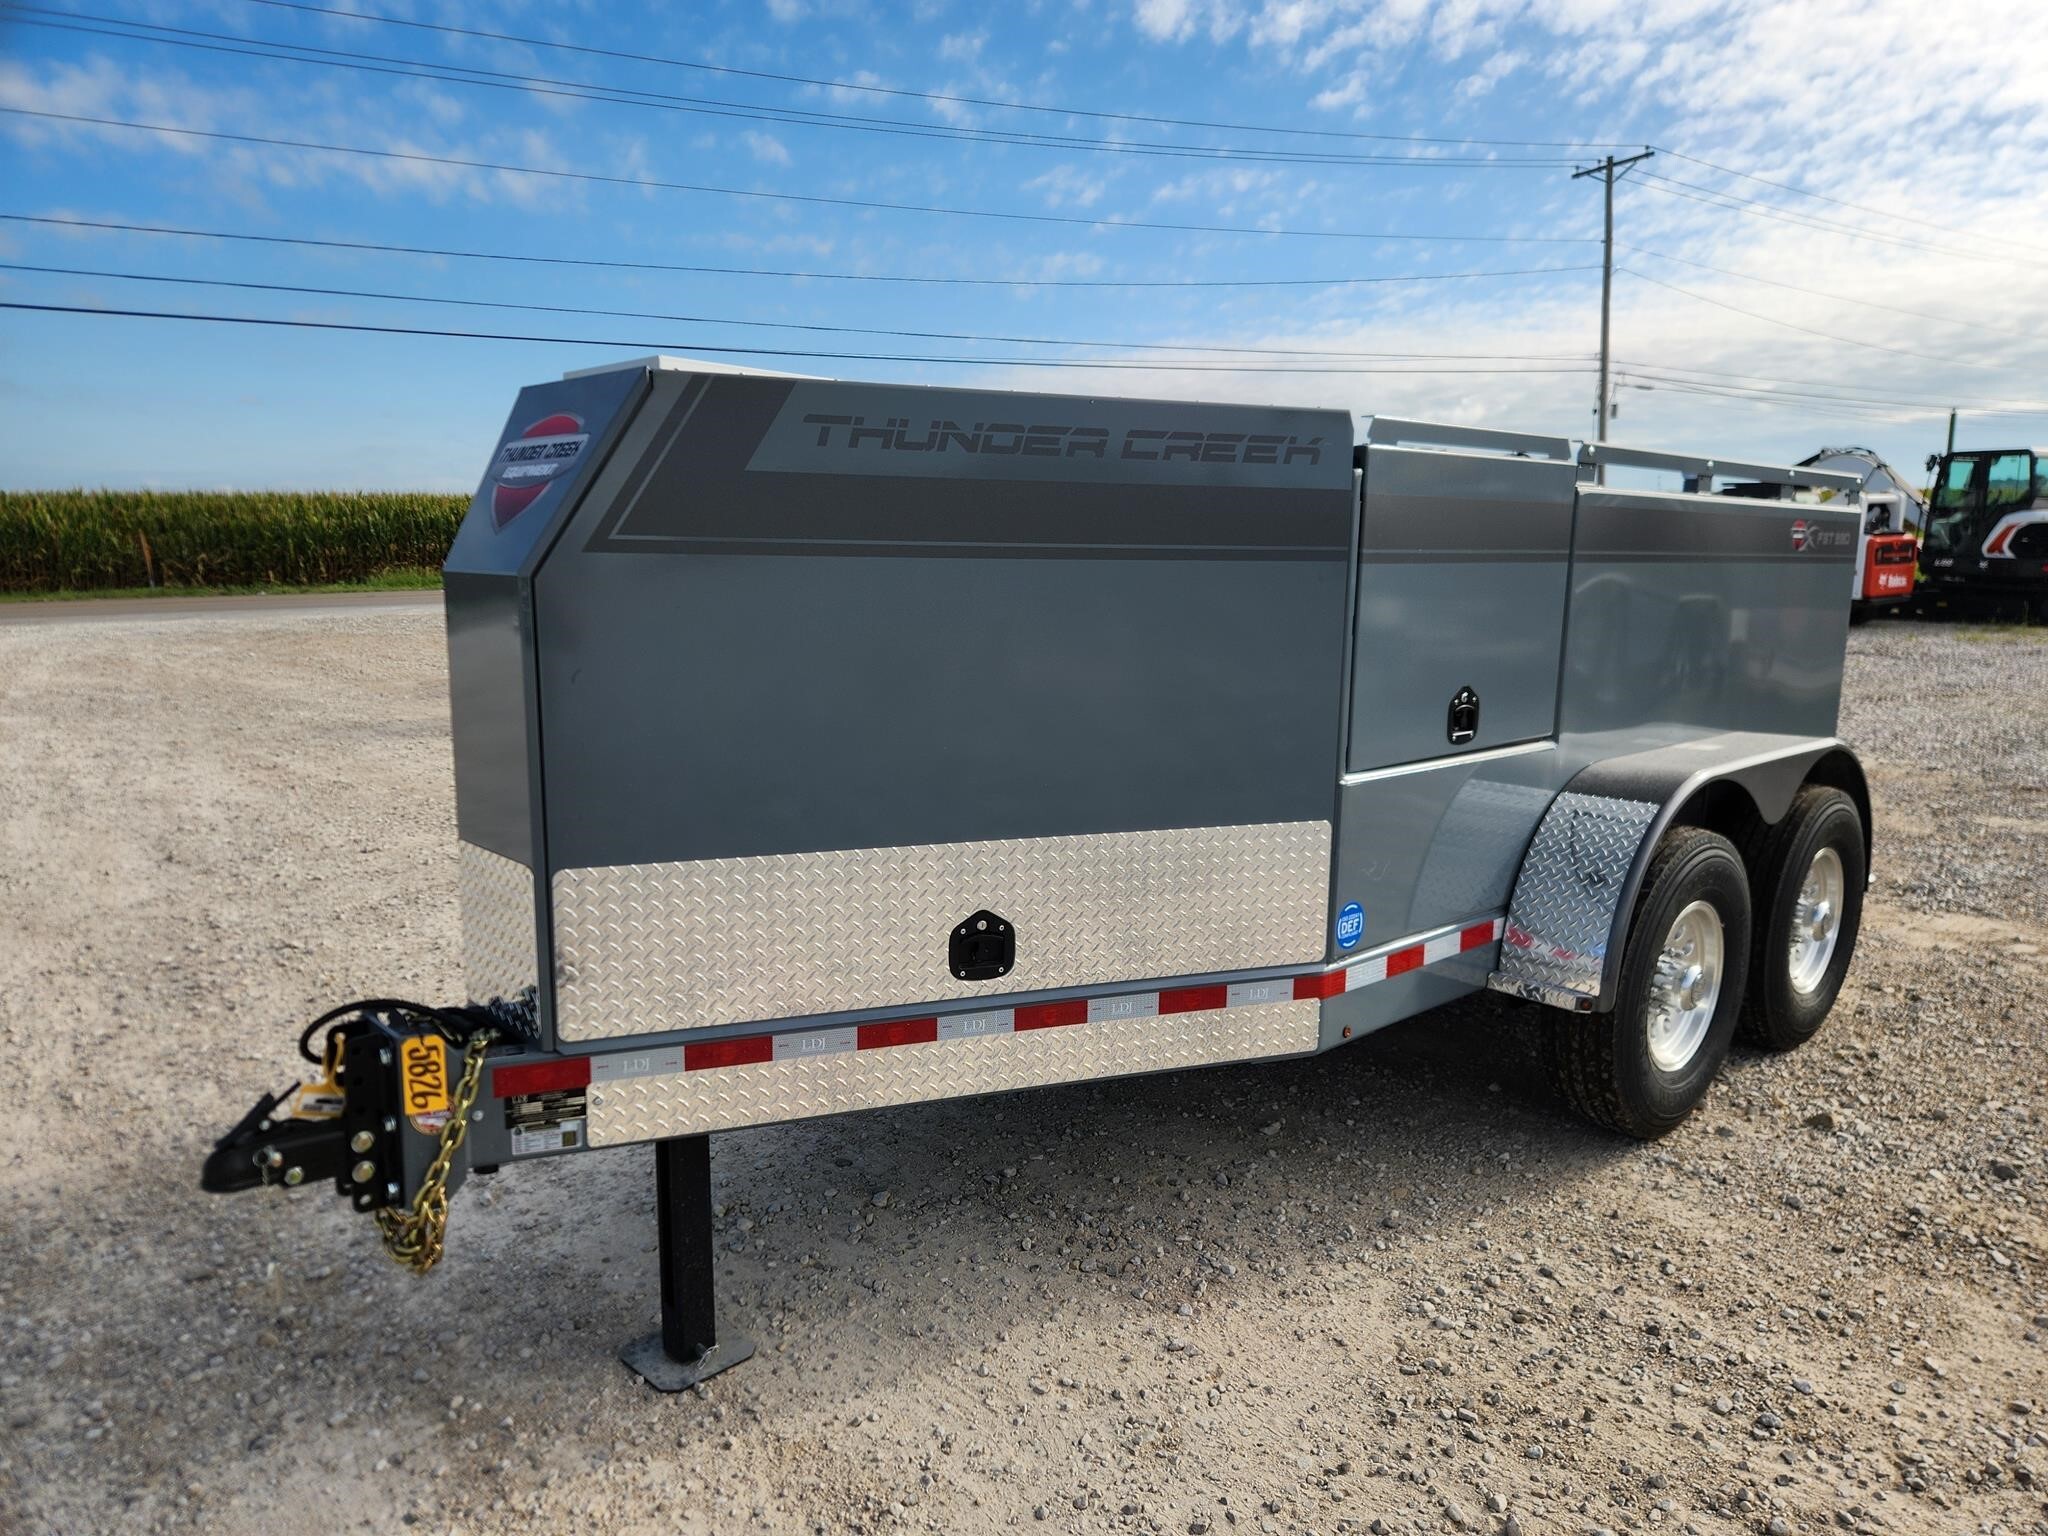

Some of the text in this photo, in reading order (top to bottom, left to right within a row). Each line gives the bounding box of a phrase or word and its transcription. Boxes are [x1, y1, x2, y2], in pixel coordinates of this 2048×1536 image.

[501, 439, 584, 462] THUNDER CREEK
[802, 412, 1326, 466] THUNDER CREEK
[1341, 918, 1360, 935] DEF
